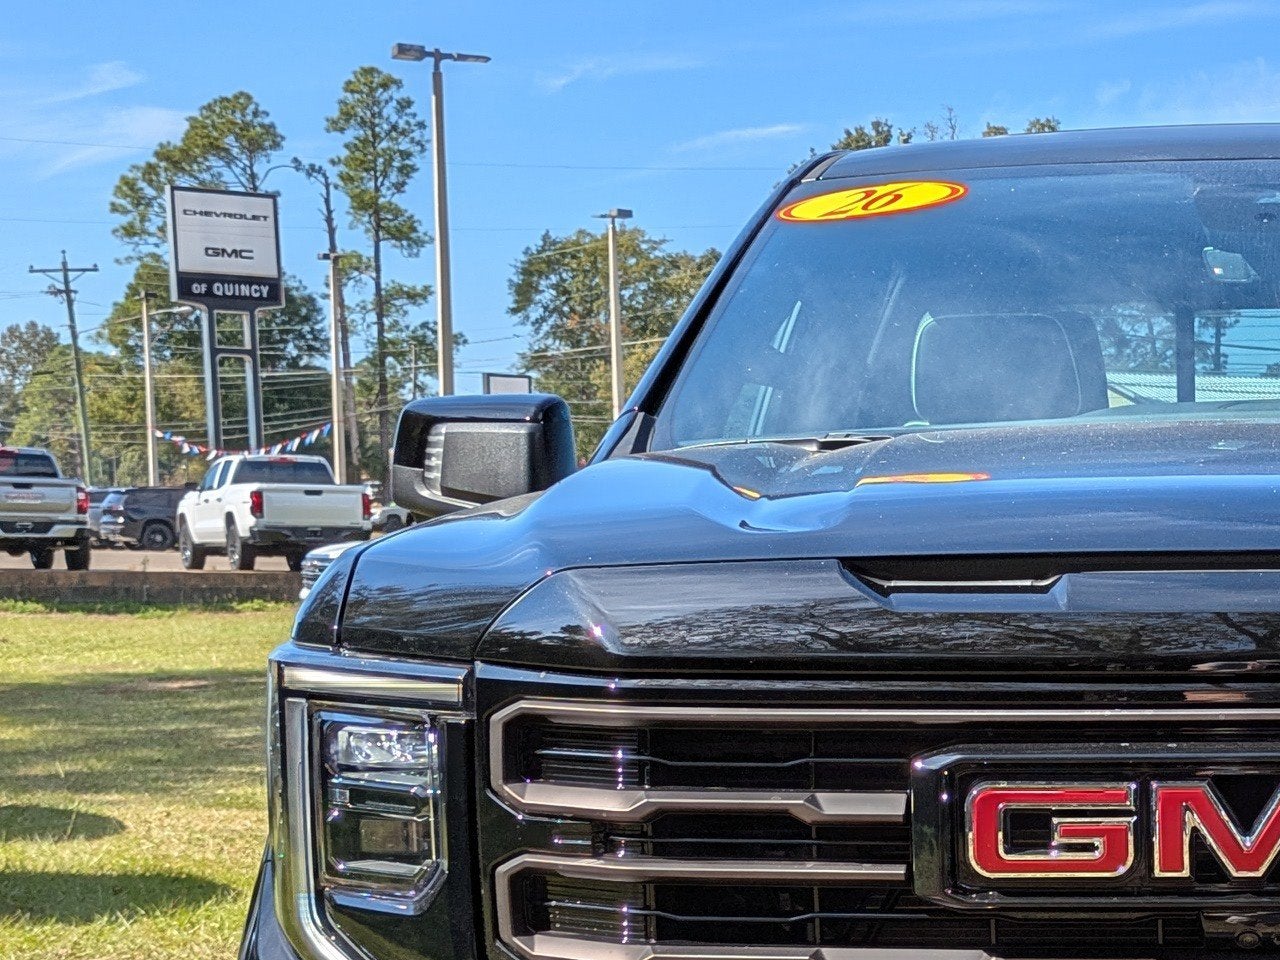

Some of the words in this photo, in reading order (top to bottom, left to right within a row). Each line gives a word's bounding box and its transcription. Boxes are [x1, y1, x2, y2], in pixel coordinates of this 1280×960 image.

[816, 183, 924, 218] 26
[182, 209, 269, 221] CHEVROLET
[204, 246, 254, 260] GMC
[191, 282, 208, 294] OF
[212, 282, 270, 298] QUINCY
